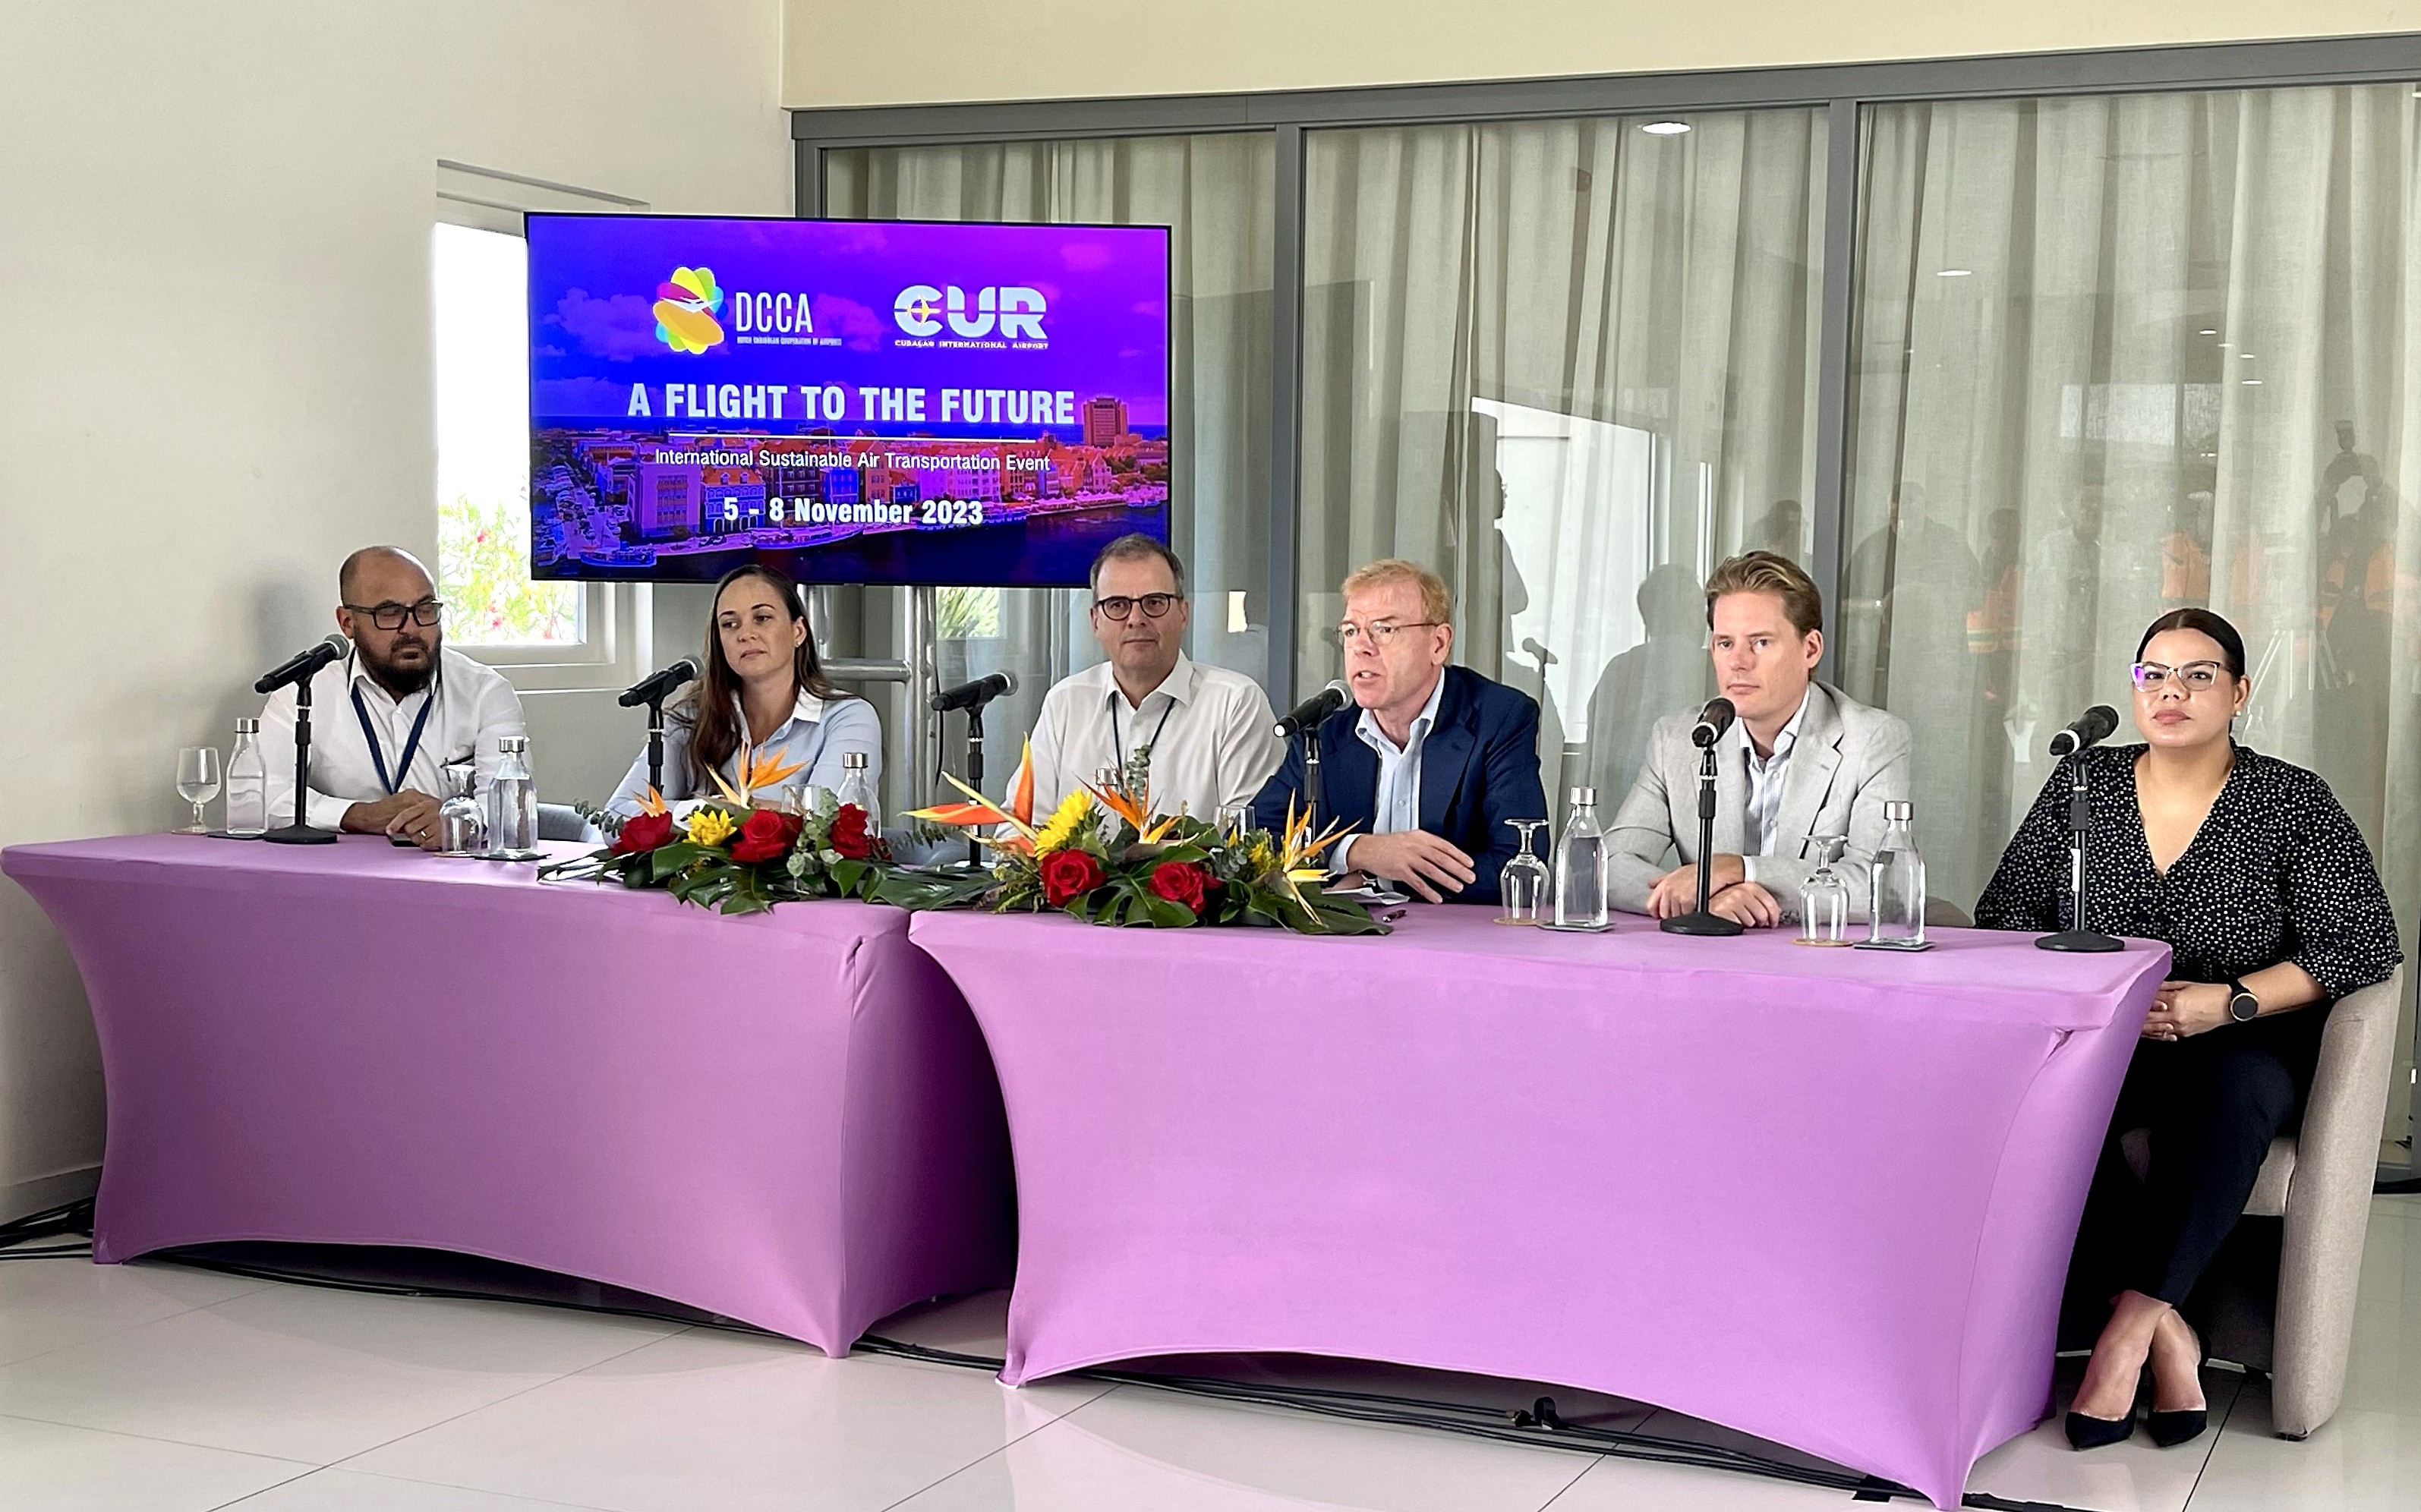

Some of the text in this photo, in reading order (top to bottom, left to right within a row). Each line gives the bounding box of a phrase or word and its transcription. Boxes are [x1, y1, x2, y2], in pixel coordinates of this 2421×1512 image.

[736, 292, 813, 332] DCCA
[894, 285, 1048, 339] CUR
[939, 340, 1007, 349] INTERNATIONAL
[627, 383, 1075, 424] A FLIGHT TO THE FUTURE
[655, 449, 1050, 471] International Sustainable Air Transportation Event
[723, 496, 739, 521] 5
[768, 496, 784, 522] 8
[794, 497, 913, 524] November
[922, 499, 984, 525] 2023
